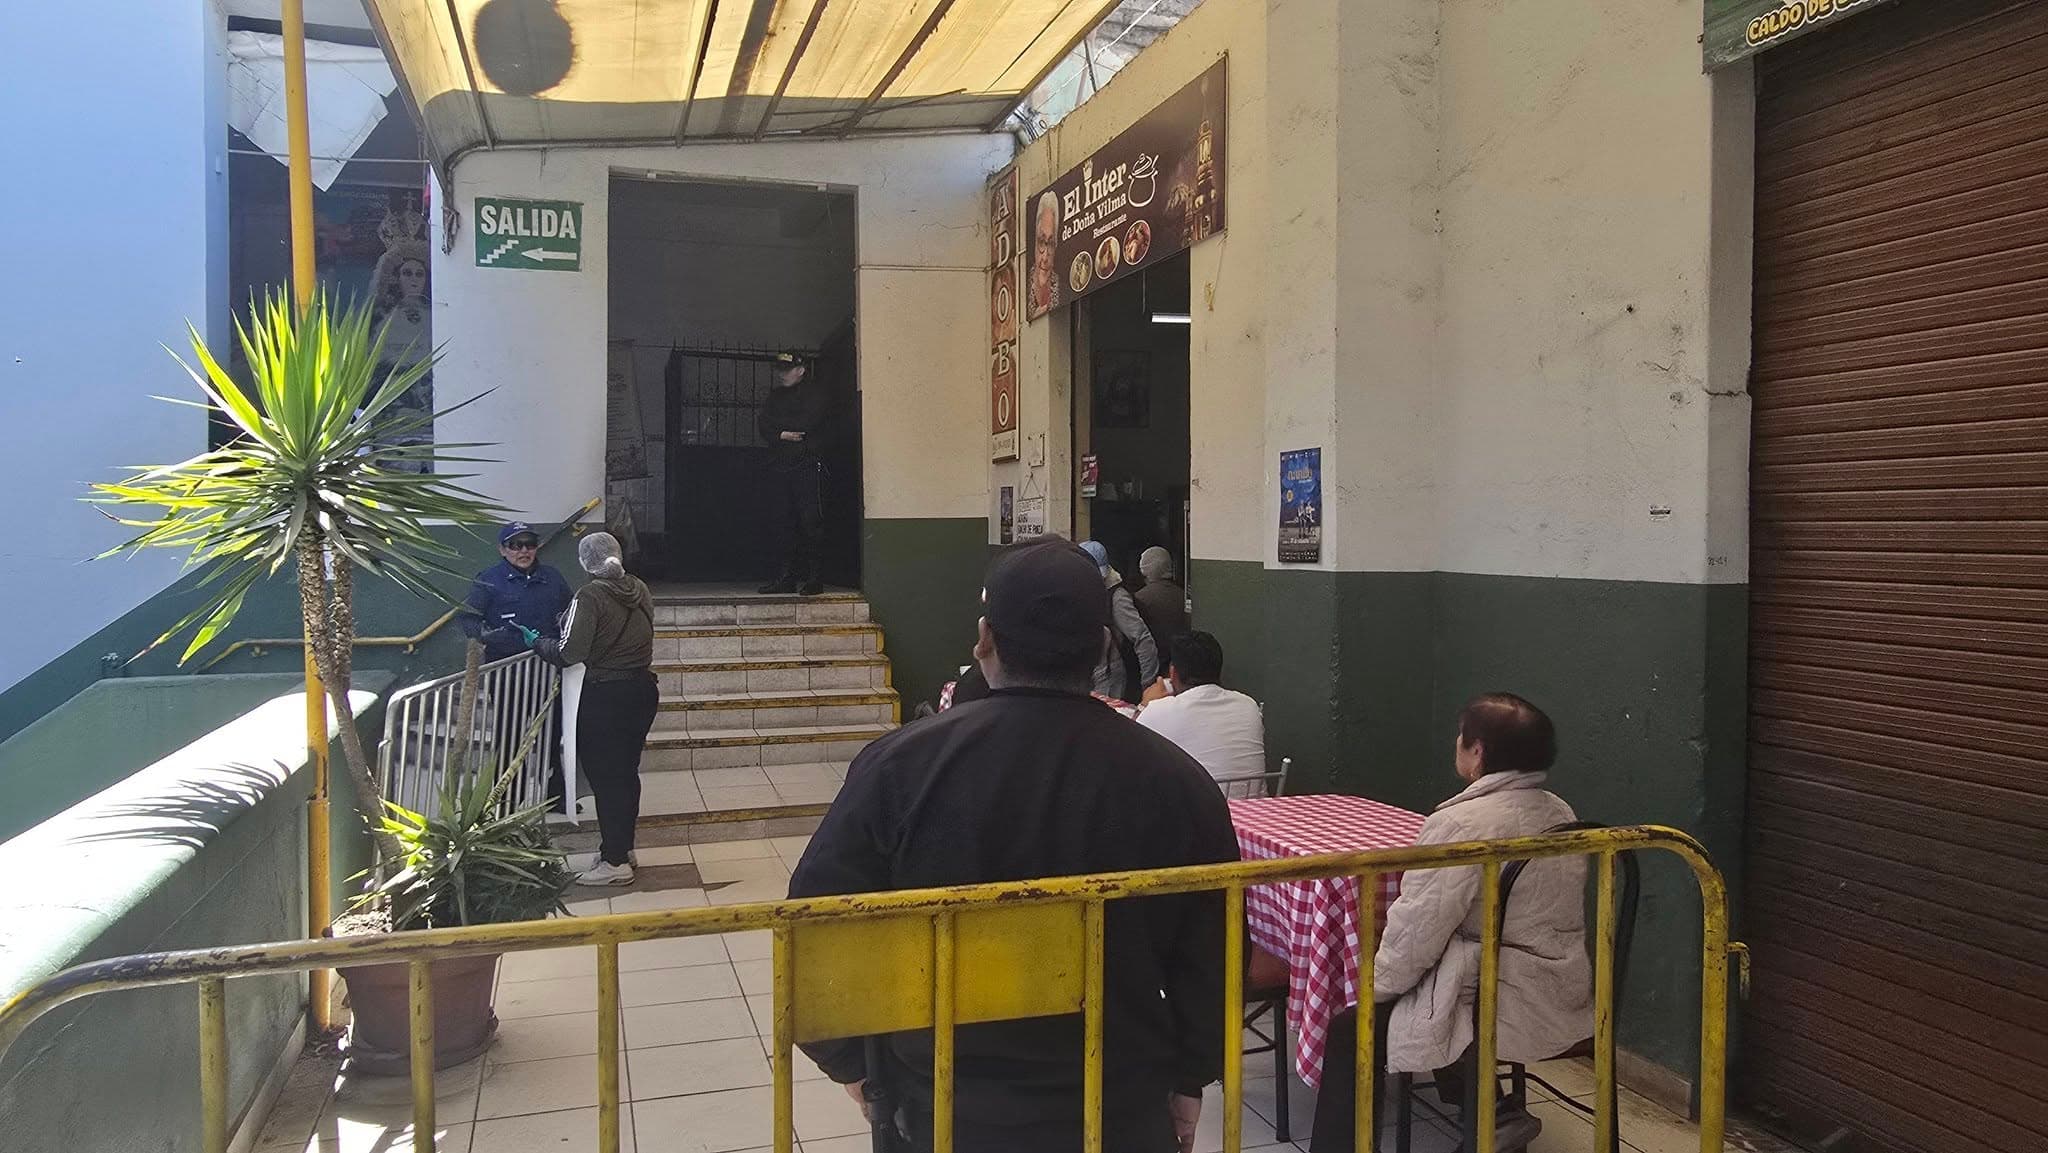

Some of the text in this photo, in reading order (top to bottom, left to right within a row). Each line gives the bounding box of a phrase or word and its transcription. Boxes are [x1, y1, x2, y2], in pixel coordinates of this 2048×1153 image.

[1748, 0, 1831, 41] CALDO DE
[1063, 162, 1127, 222] El Inter
[480, 204, 577, 239] SALIDA
[1062, 193, 1127, 241] de Doña Vilma
[996, 184, 1010, 428] ADOBO
